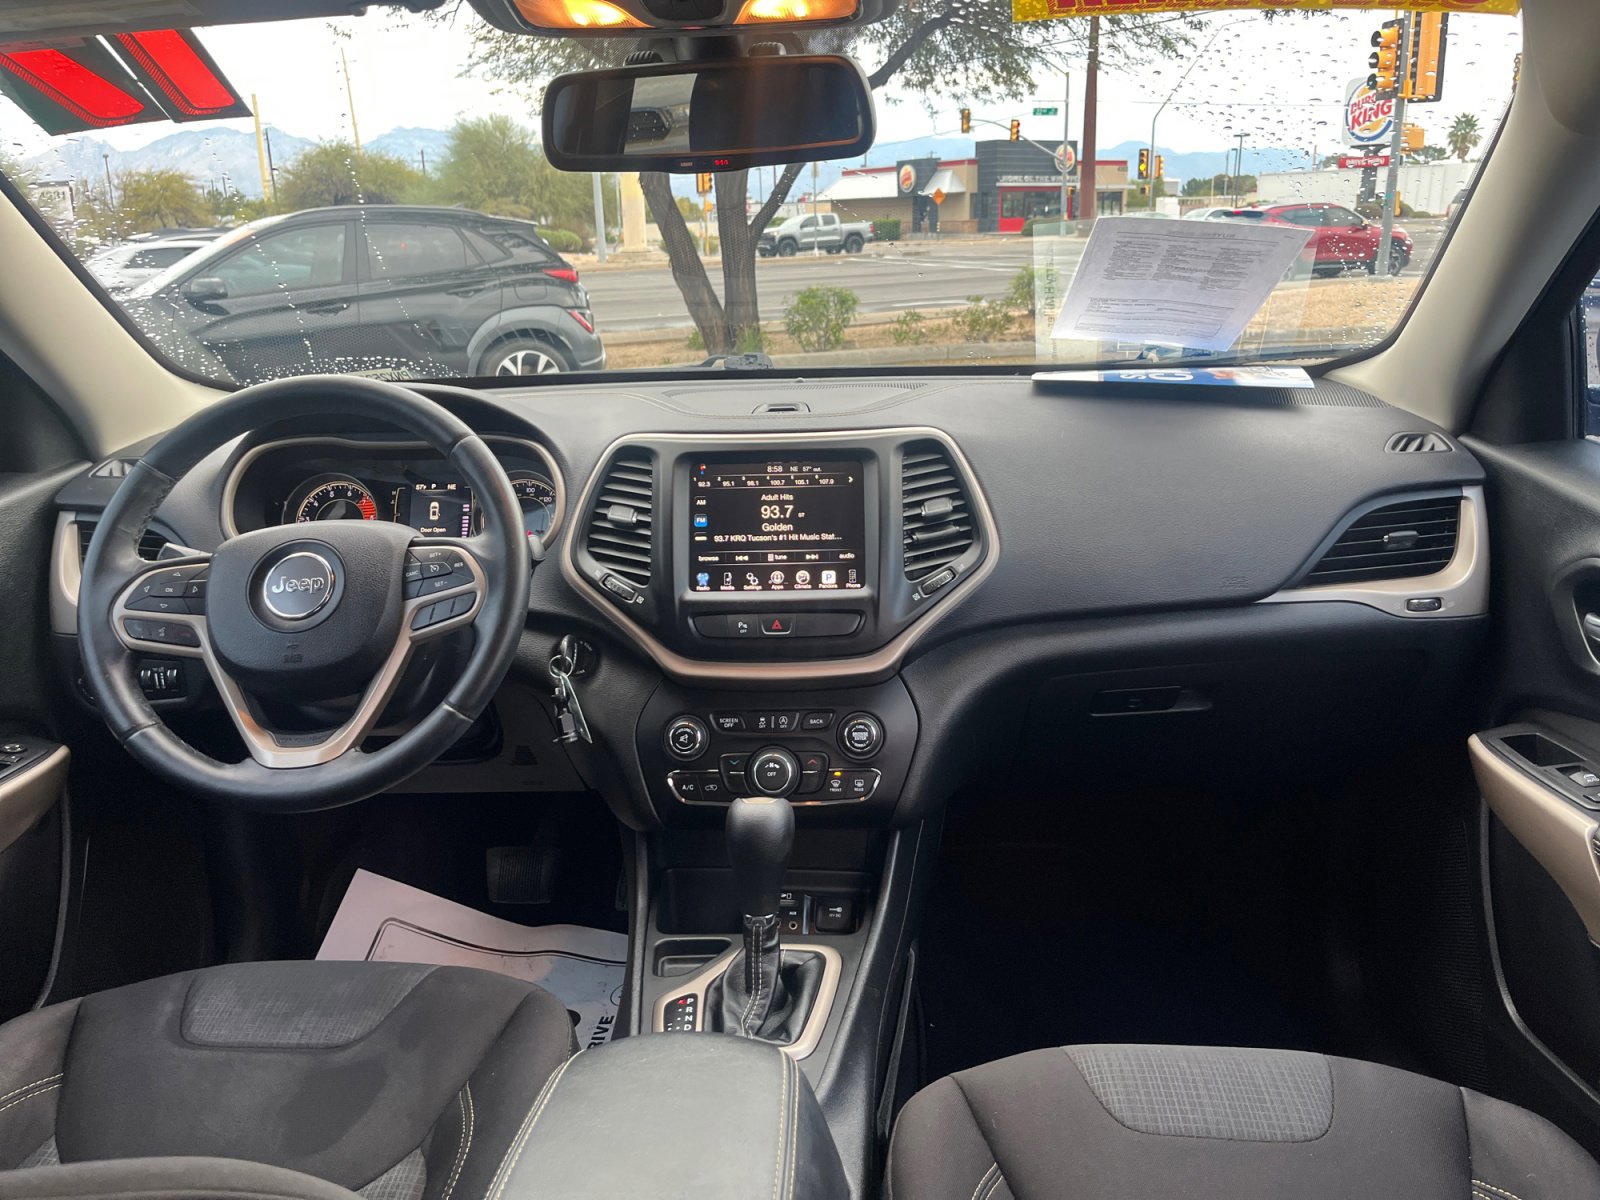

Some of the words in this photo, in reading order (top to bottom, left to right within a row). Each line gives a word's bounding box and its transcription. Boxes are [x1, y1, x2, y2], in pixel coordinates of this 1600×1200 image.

[1351, 98, 1392, 131] KING
[329, 490, 335, 498] 5
[761, 505, 794, 518] 93.7
[762, 523, 793, 532] Golden
[271, 576, 325, 594] Jeep
